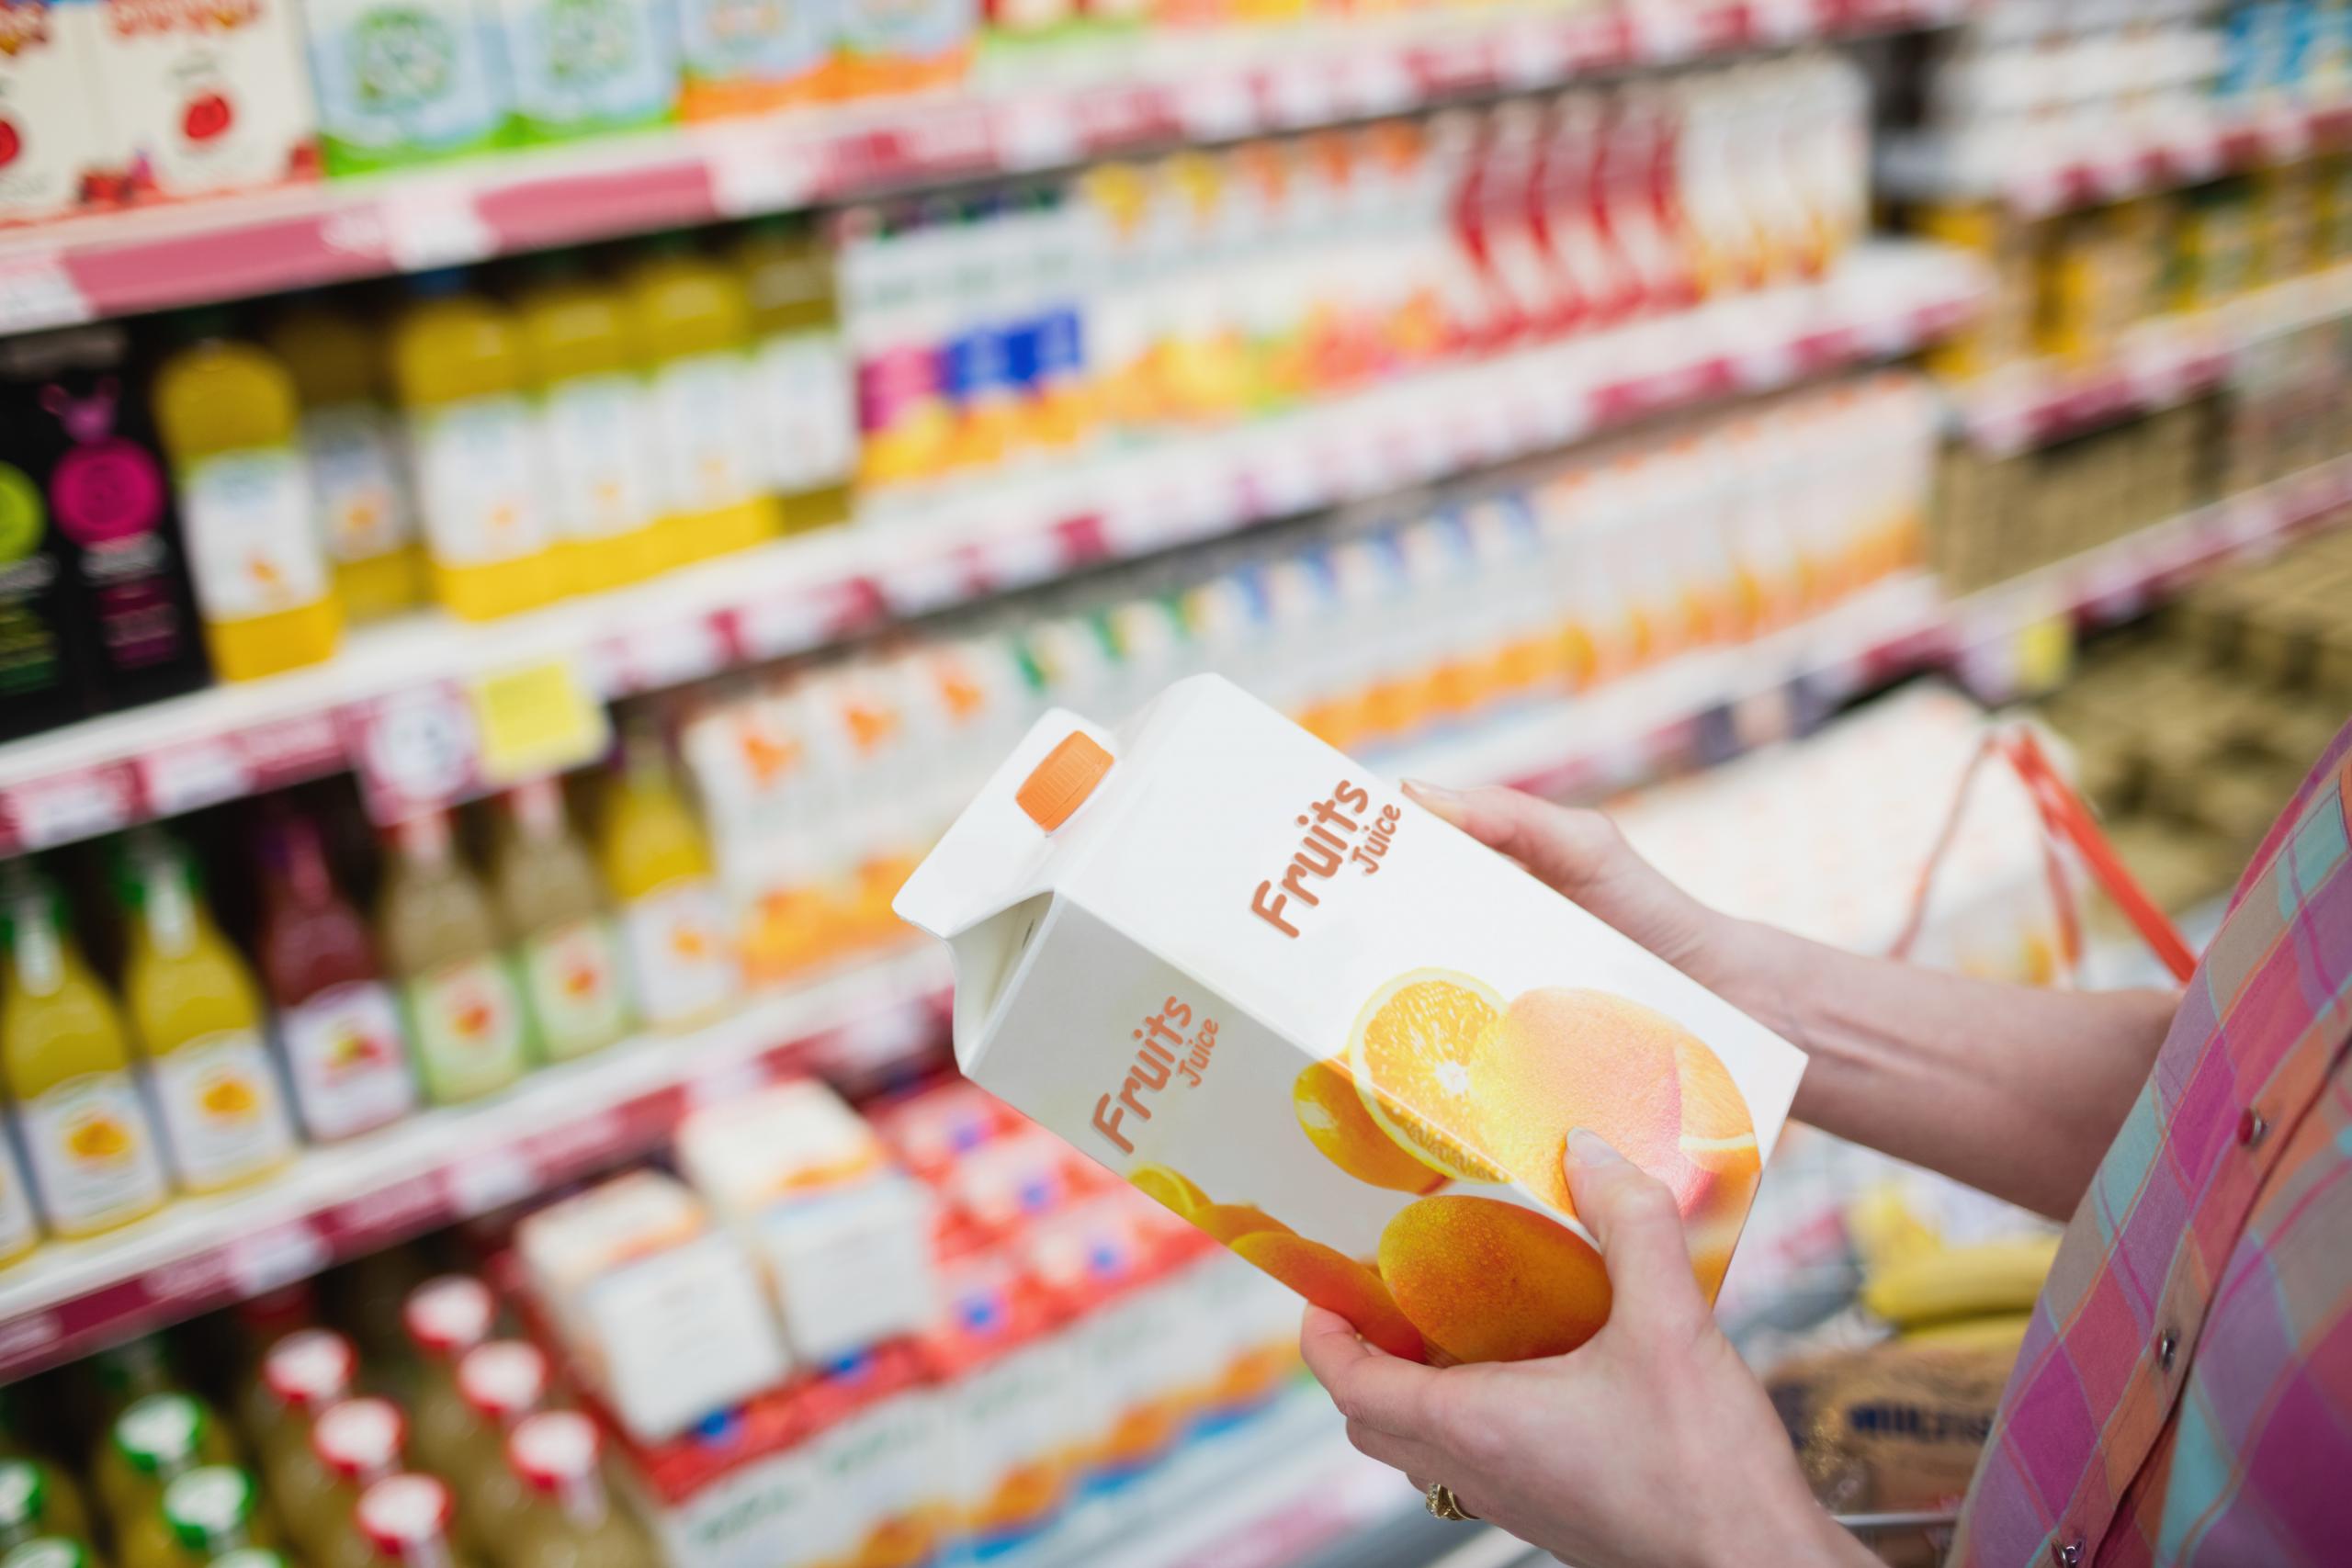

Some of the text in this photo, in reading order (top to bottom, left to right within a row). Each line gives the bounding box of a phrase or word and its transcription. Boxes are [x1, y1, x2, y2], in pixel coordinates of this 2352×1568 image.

[1250, 778, 1369, 939] Fruits
[1351, 803, 1402, 875] Juice
[1091, 995, 1193, 1156] Fruits
[1177, 1017, 1220, 1089] Juice
